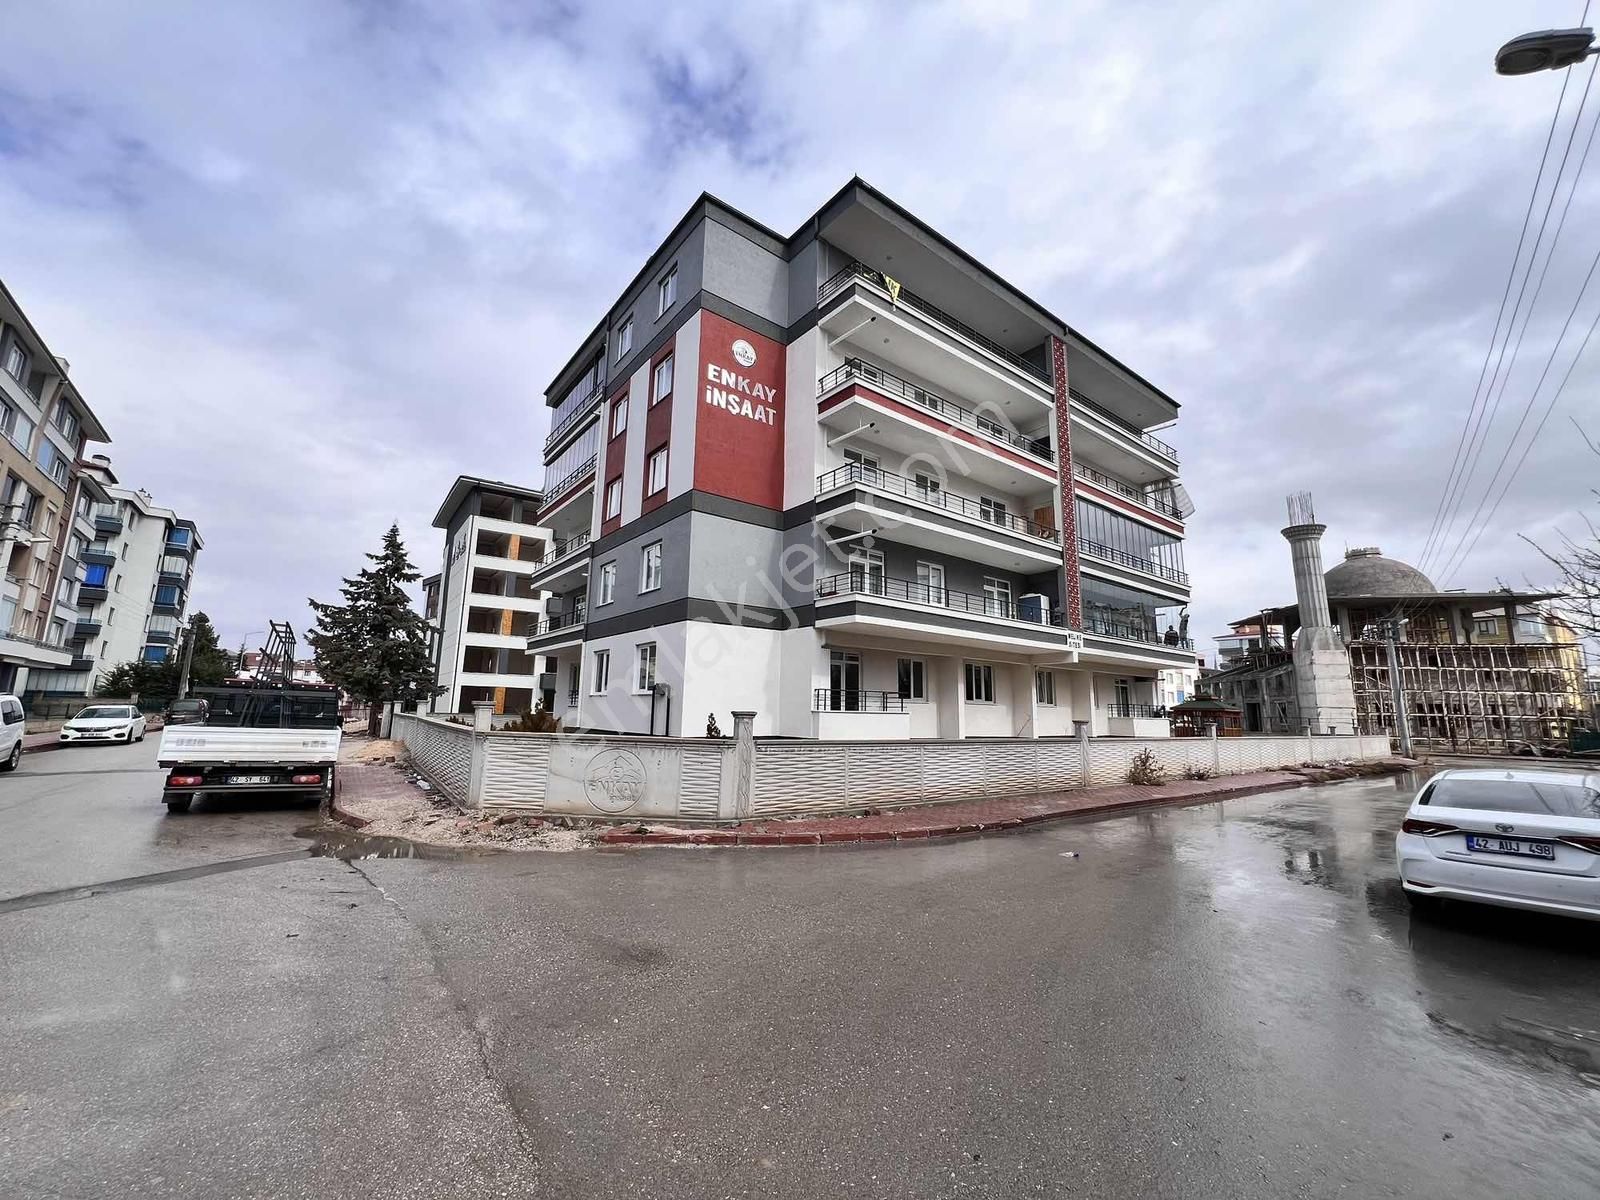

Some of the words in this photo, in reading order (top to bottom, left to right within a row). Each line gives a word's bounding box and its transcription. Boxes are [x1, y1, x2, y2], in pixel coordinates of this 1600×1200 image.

[707, 363, 777, 403] ENKAY
[1475, 839, 1489, 849] 42
[1498, 840, 1520, 852] AUJ
[1529, 843, 1551, 856] 498
